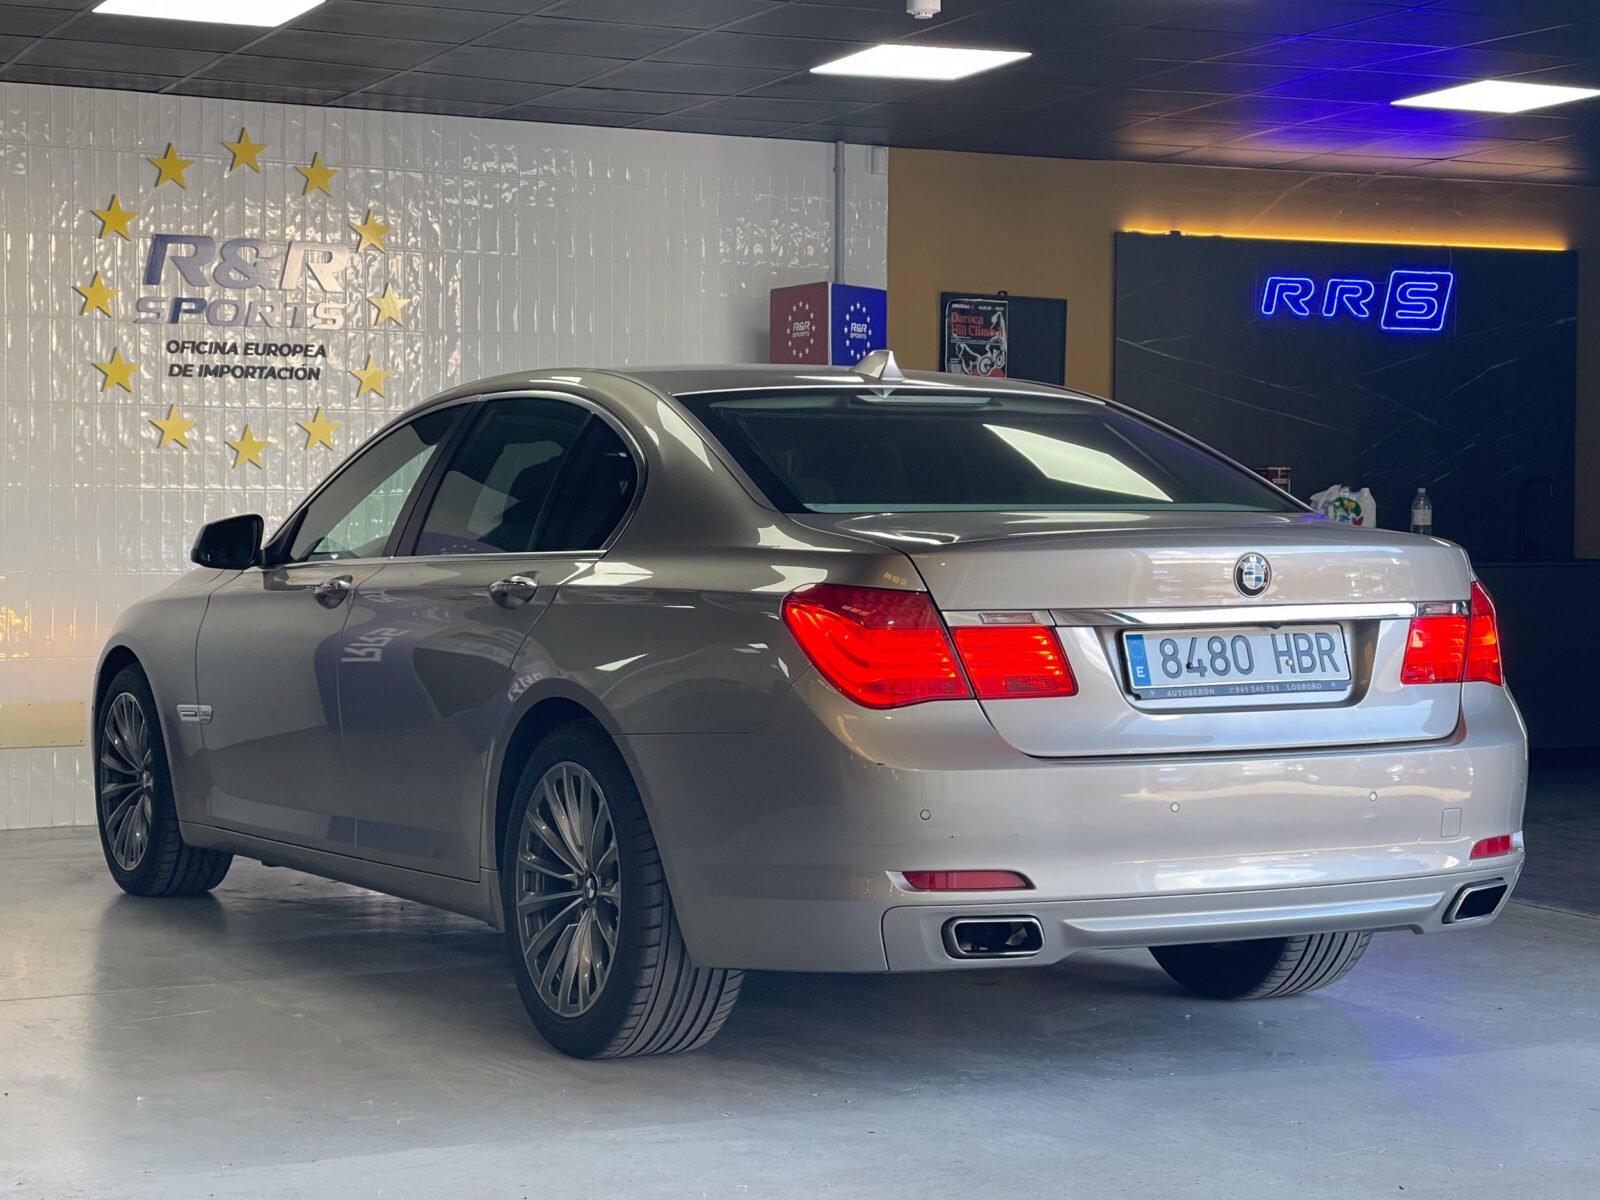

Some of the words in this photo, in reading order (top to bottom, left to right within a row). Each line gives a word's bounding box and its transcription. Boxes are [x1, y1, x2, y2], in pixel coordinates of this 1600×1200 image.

[142, 234, 351, 293] R&R
[133, 297, 348, 330] SPORTS
[793, 321, 811, 331] R&R
[850, 323, 868, 333] R&R
[849, 332, 867, 340] SPORTS
[166, 340, 239, 356] OFICINA
[243, 342, 327, 359] EUROPEA
[168, 364, 193, 378] DE
[198, 363, 321, 381] IMPORTACIÓN
[1159, 634, 1255, 679] 8480
[1271, 632, 1341, 674] HBR
[1136, 665, 1145, 678] E
